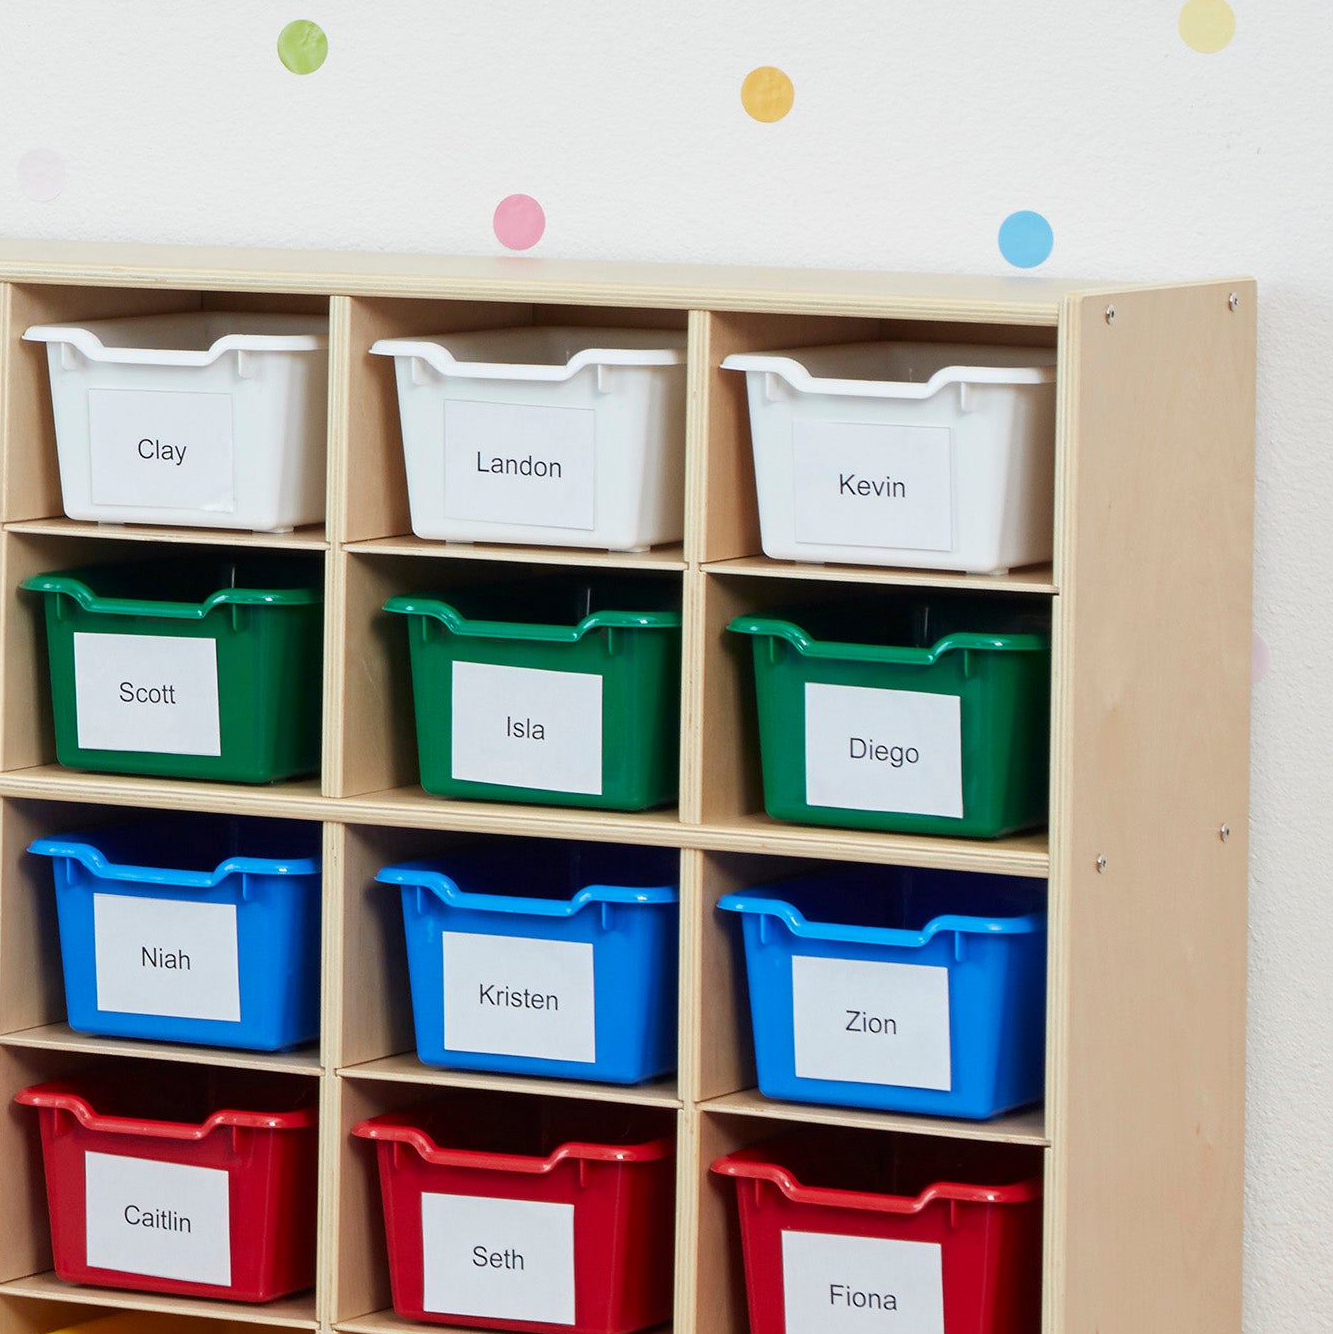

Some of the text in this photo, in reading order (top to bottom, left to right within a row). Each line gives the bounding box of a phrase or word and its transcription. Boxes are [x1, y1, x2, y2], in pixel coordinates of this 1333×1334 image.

[137, 438, 187, 467] Clay
[477, 450, 562, 479] Landon
[839, 473, 906, 498] Kevin
[119, 681, 177, 705] Scott
[507, 715, 545, 741] Isla
[849, 737, 920, 769] Diego
[141, 946, 191, 971] Niah
[479, 983, 559, 1011] Kristen
[845, 1009, 897, 1035] Zion
[124, 1204, 192, 1234] Caitlin
[472, 1245, 525, 1271] Seth
[829, 1283, 898, 1311] Fiona
